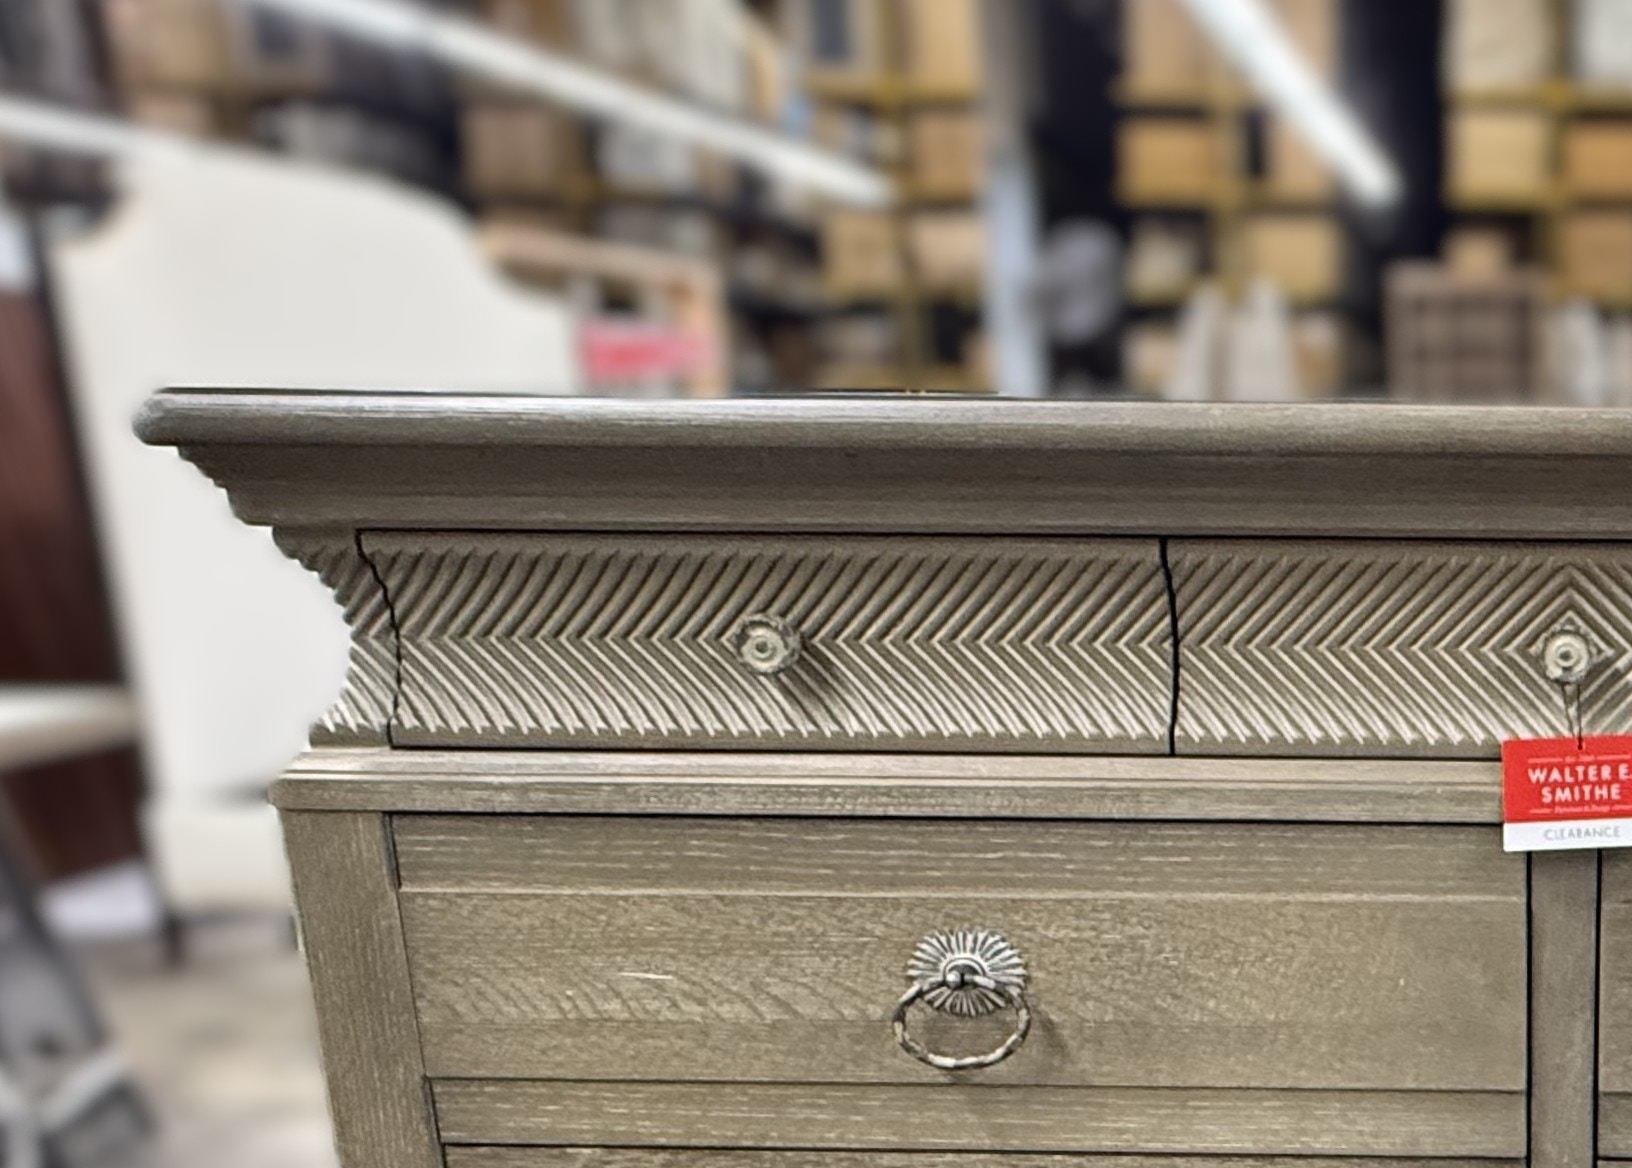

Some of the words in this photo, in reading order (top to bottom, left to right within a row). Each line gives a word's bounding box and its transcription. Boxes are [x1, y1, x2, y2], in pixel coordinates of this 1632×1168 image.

[1527, 764, 1612, 784] WALTER
[1541, 783, 1621, 804] SMITHE
[1544, 826, 1621, 841] CLEARANCE
